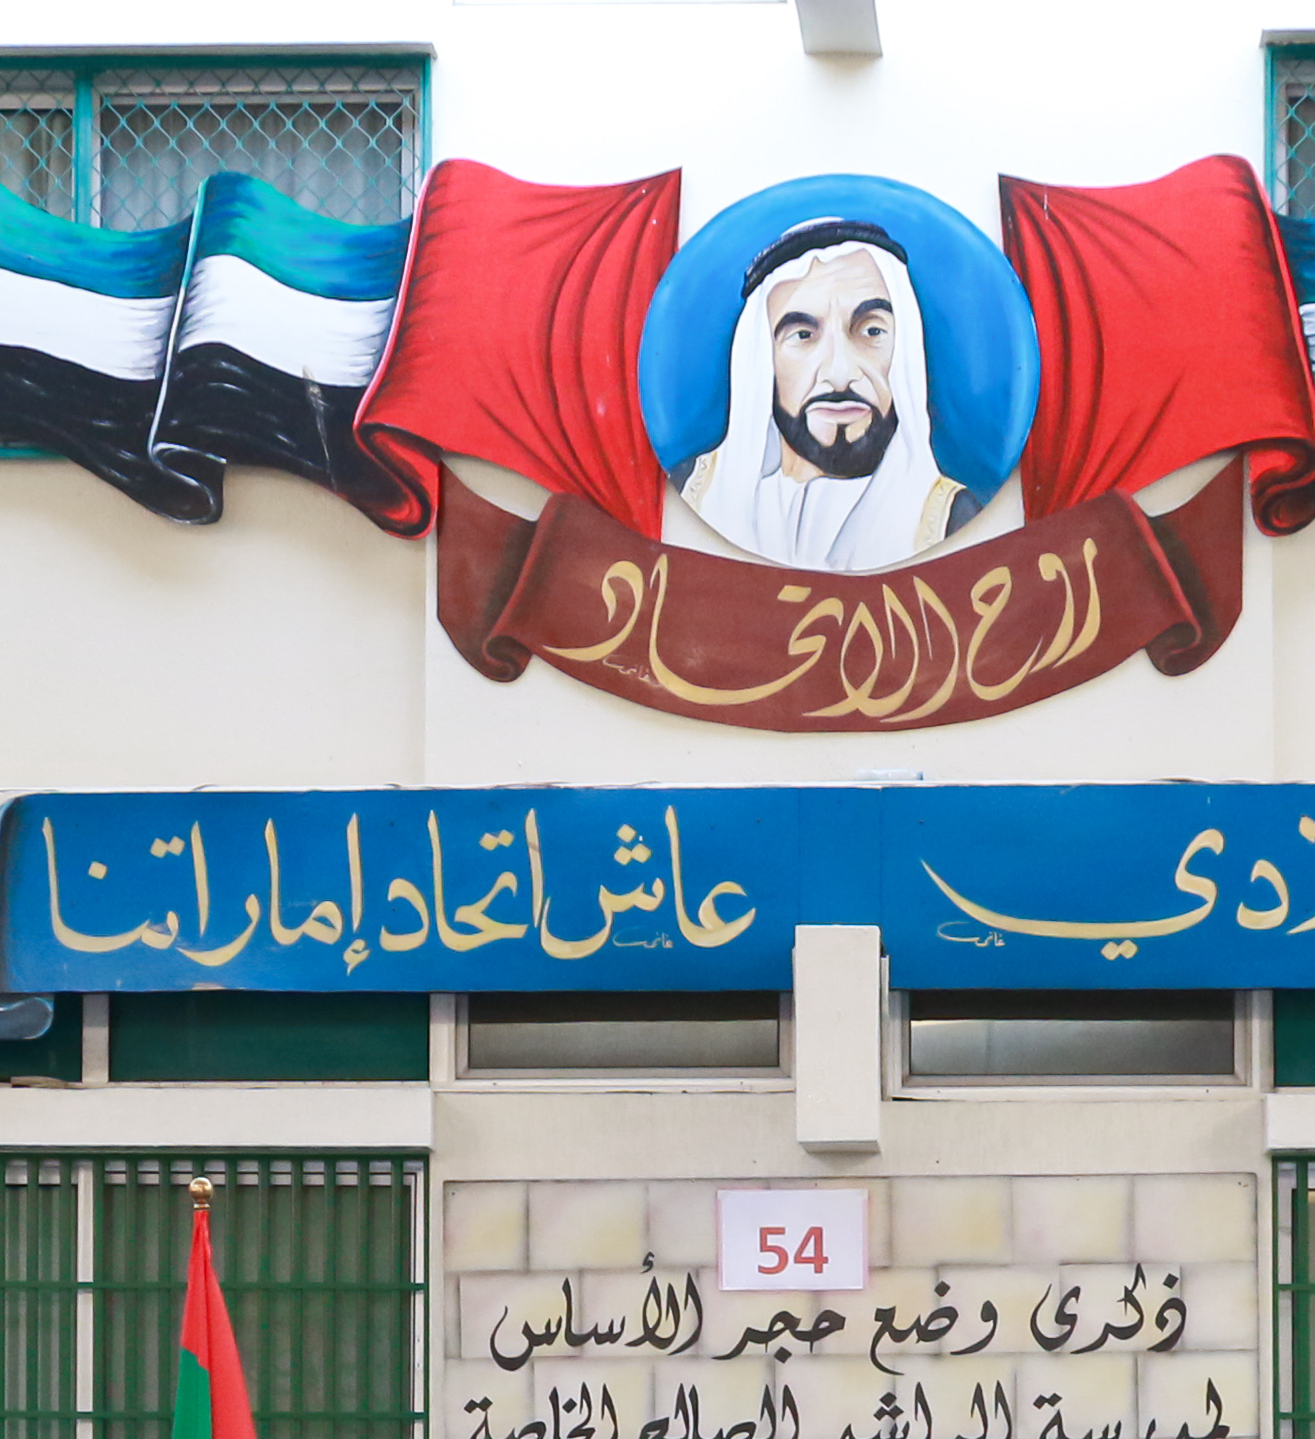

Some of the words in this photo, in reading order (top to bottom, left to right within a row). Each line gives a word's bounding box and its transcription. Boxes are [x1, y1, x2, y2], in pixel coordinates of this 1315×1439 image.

[542, 552, 962, 723] الاتحاد
[965, 537, 1102, 702] روح
[43, 812, 370, 973] إماراتنا
[379, 807, 543, 953] اتحاد
[540, 804, 756, 958] عاش
[490, 1252, 703, 1372] الأساس
[758, 1226, 829, 1275] 54
[713, 1309, 847, 1363] حجر
[870, 1280, 1000, 1376] وضع
